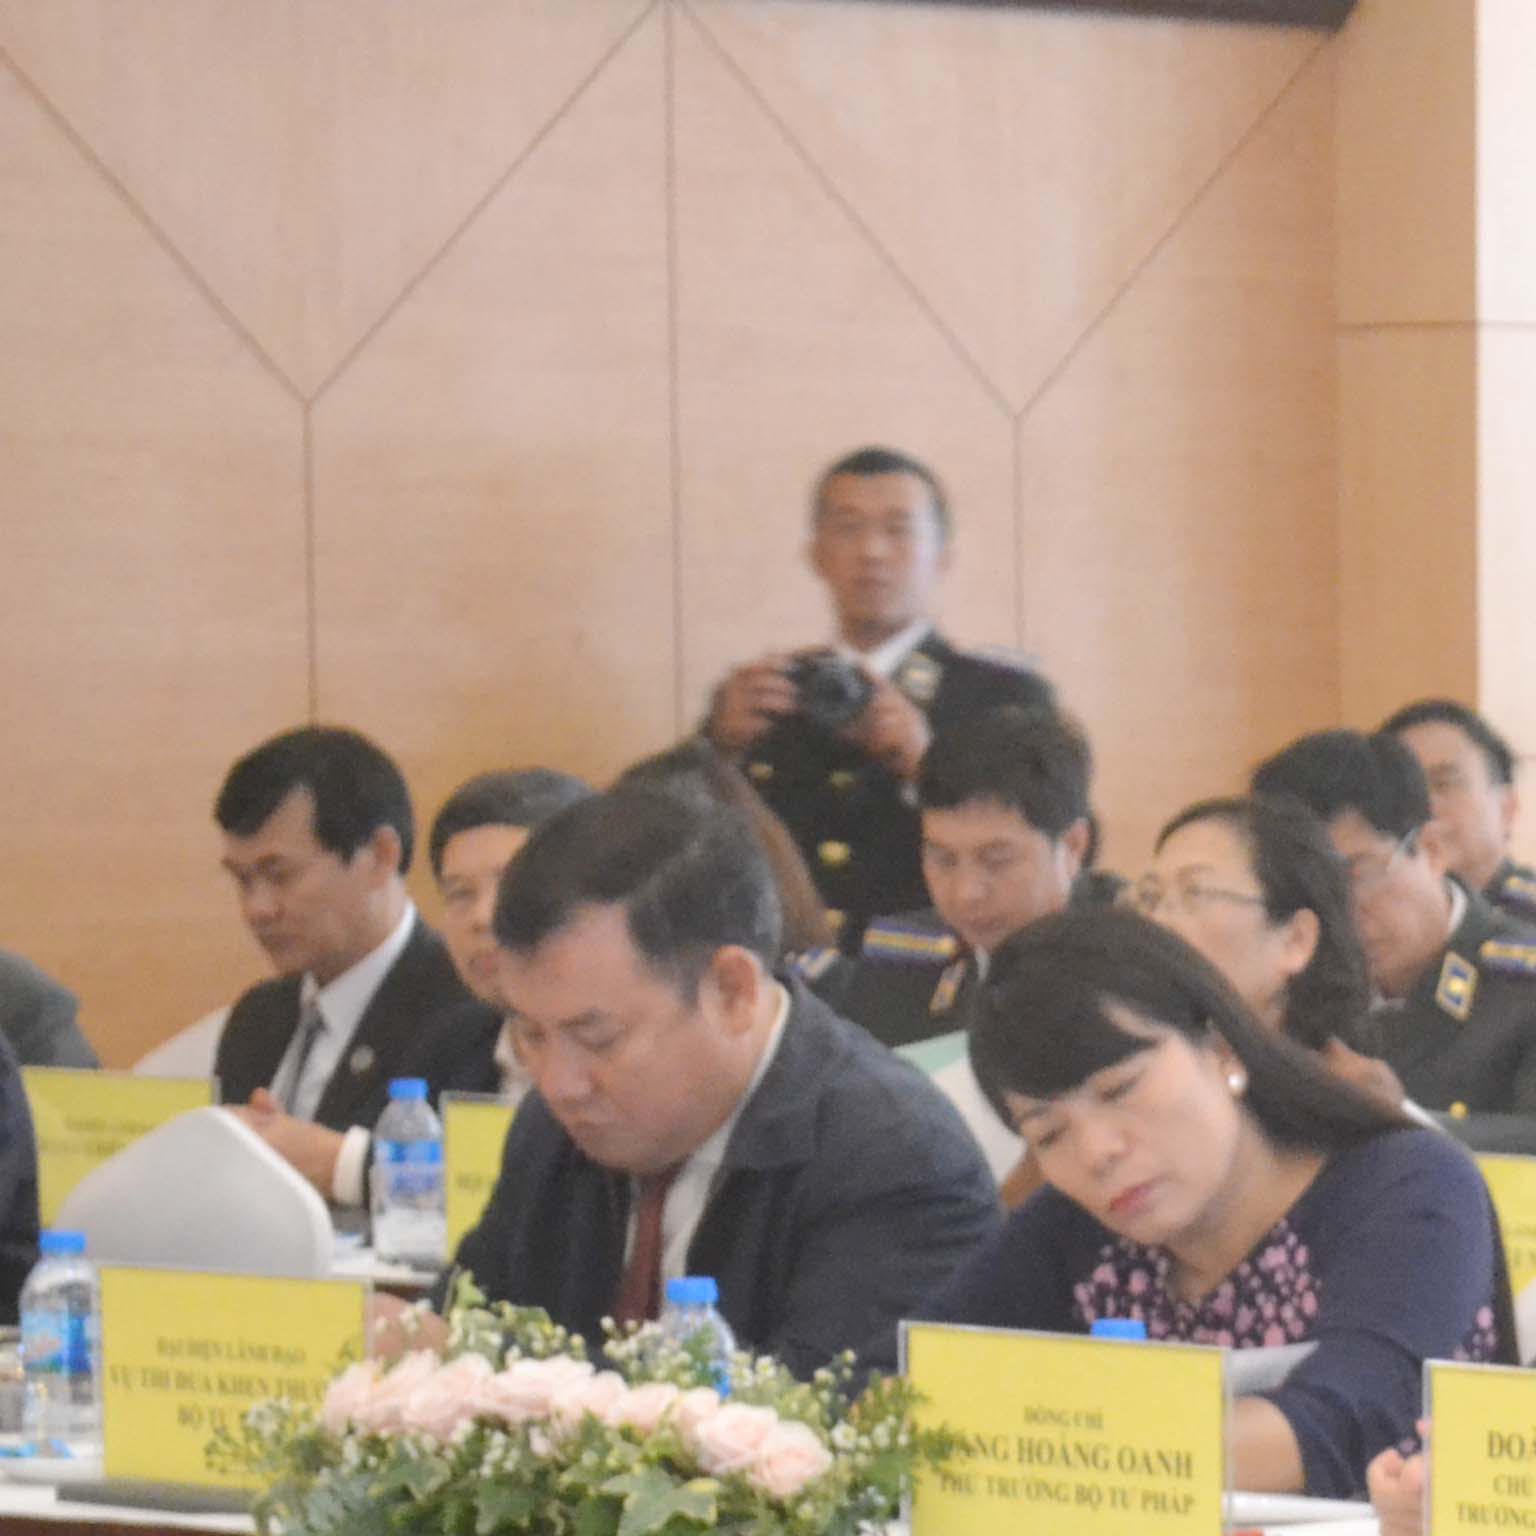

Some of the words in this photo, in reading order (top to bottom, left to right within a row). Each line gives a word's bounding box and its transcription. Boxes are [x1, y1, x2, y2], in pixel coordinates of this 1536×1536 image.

[1017, 1432, 1109, 1473] HOÀNG
[1117, 1446, 1193, 1479] OANH
[1075, 1481, 1103, 1510] BỘ
[1140, 1485, 1194, 1515] PHÁP
[1493, 1471, 1532, 1498] CHỦ
